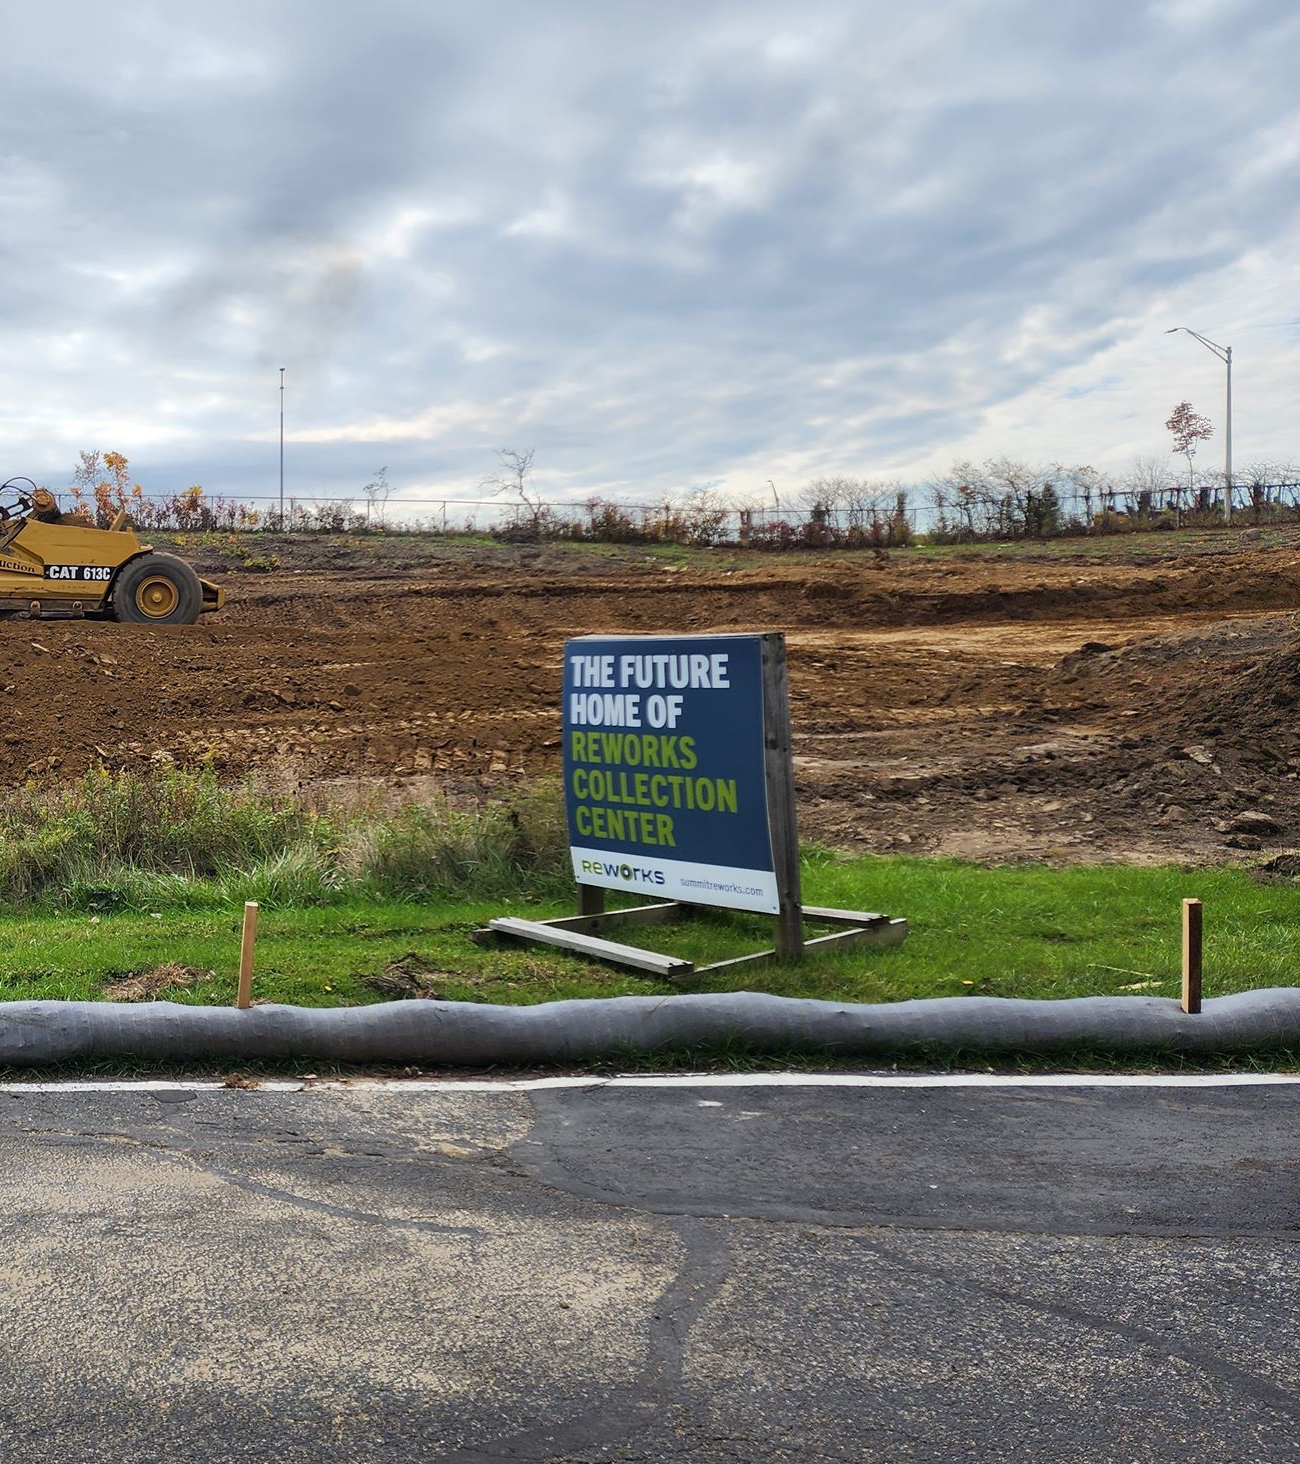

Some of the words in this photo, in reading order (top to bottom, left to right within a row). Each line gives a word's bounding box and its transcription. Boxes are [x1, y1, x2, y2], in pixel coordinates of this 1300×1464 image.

[49, 565, 78, 579] CAT
[83, 567, 111, 580] 613C
[570, 655, 615, 687] THE
[620, 653, 730, 689] FUTURE
[570, 693, 642, 728] HOME
[646, 694, 684, 729] OF
[571, 731, 698, 769] REWORKS
[573, 768, 738, 813] COLLECTION
[576, 805, 677, 847] CENTER
[680, 877, 764, 897] summitreworks.com
